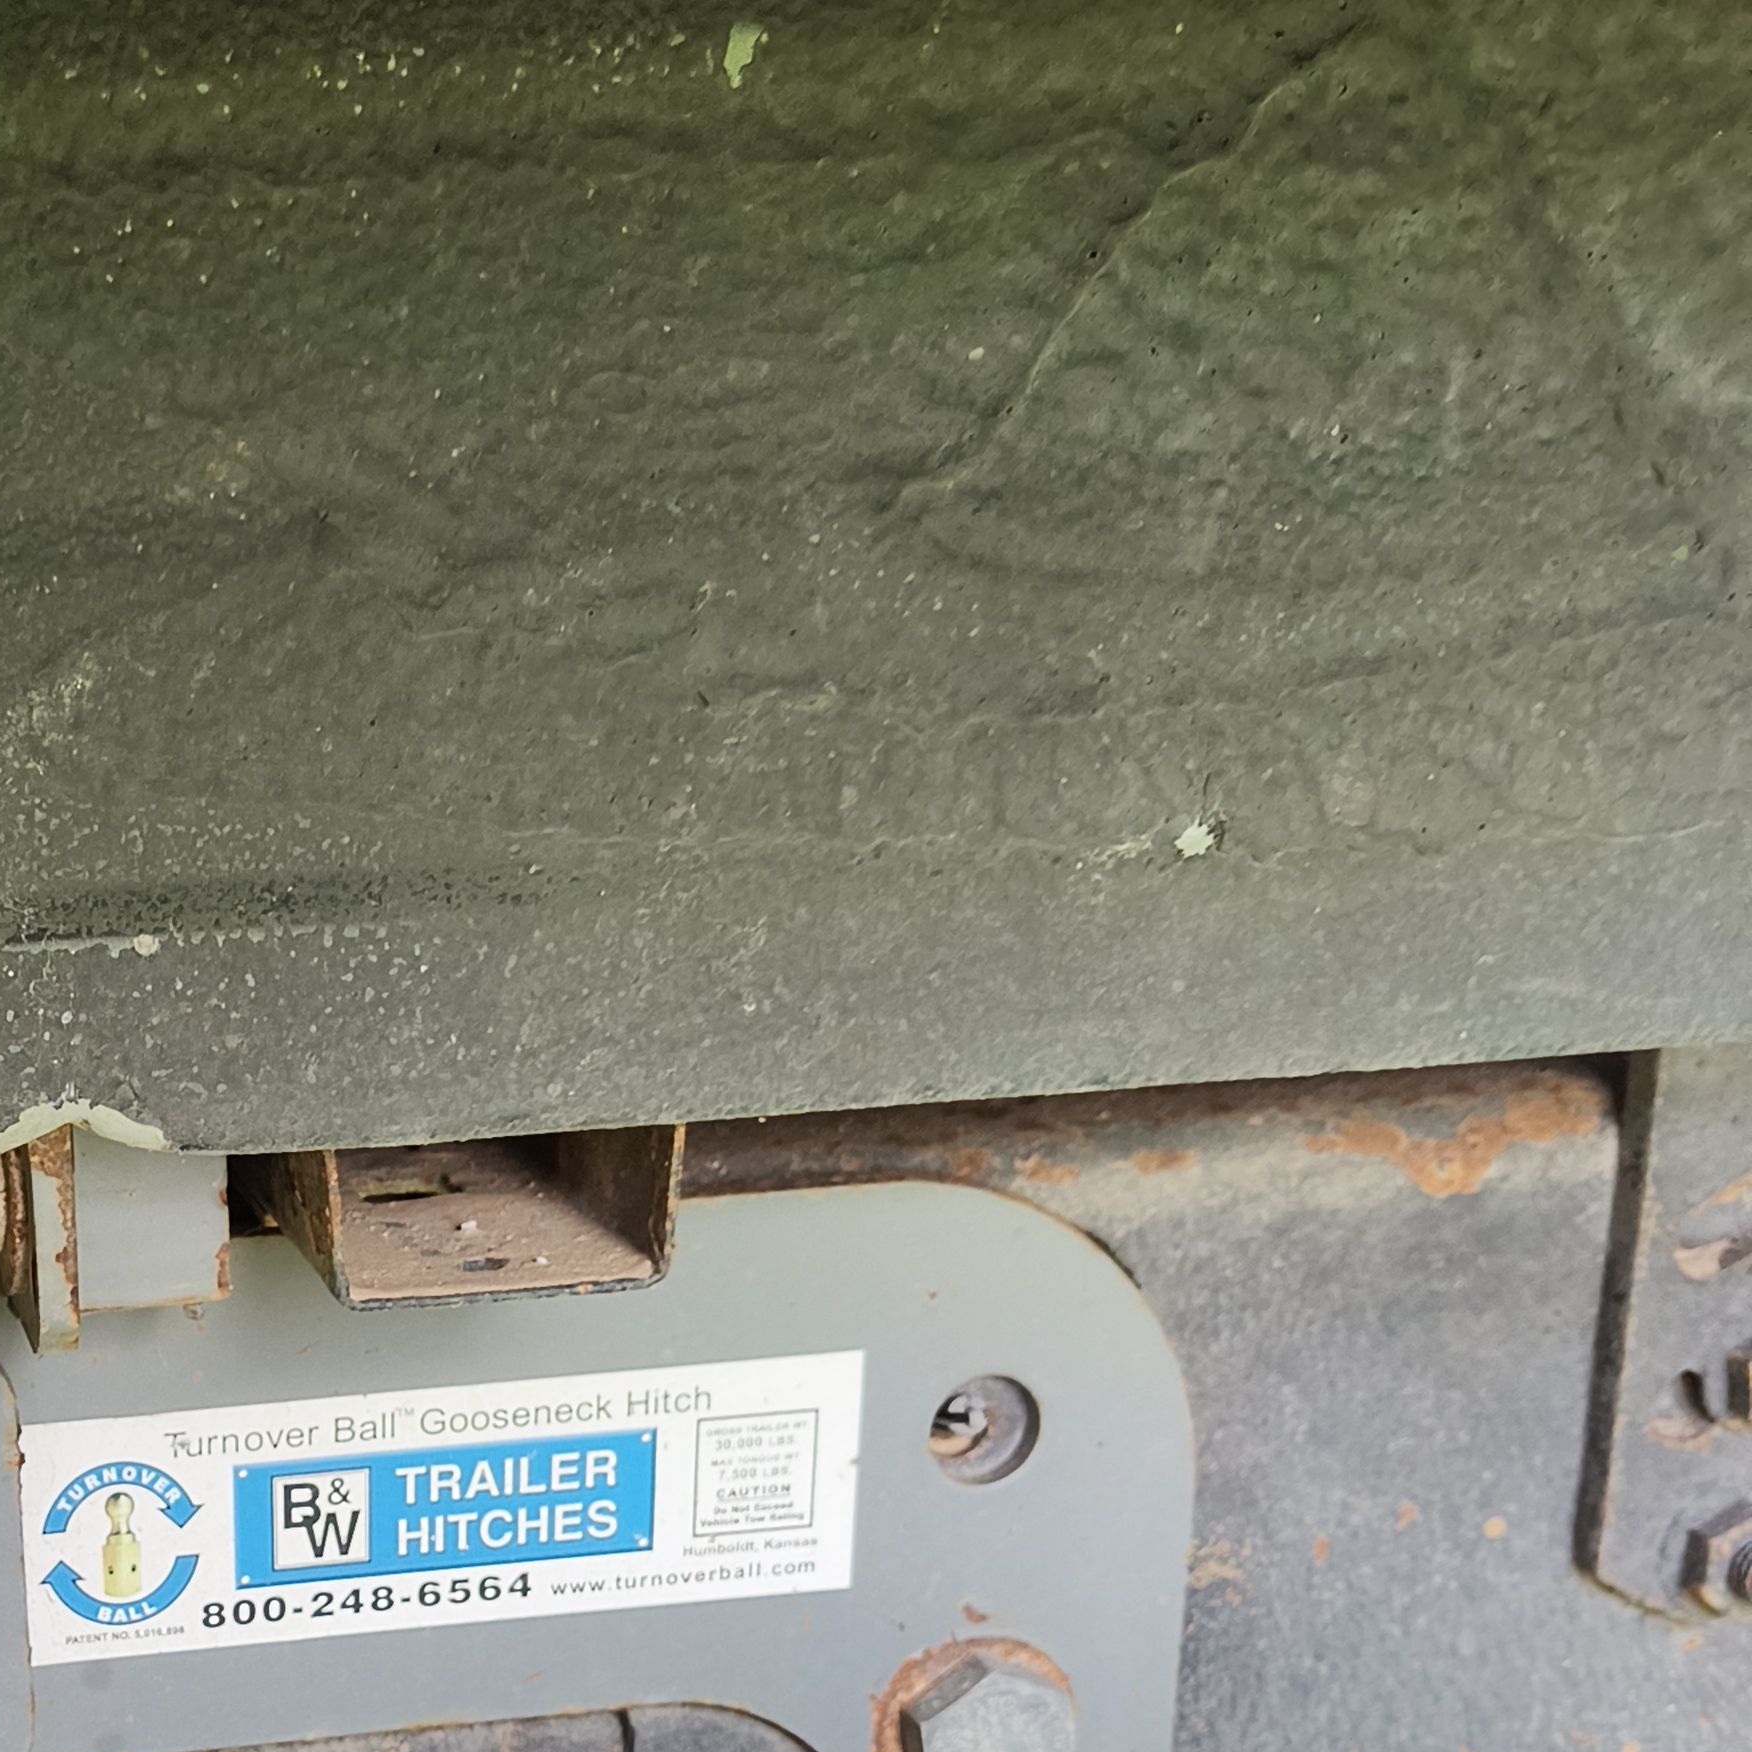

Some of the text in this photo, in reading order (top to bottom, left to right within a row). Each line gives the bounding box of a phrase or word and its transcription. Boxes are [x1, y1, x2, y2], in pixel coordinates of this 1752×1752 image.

[165, 1425, 319, 1458] Turnover
[420, 1395, 613, 1435] Gooseneck
[627, 1386, 712, 1417] Hitch
[55, 1466, 182, 1512] TURNOVER
[396, 1449, 617, 1505] TRAILER
[716, 1484, 791, 1499] CAUTION
[398, 1500, 618, 1556] HITCHES
[700, 1516, 739, 1527] Vehicle
[764, 1537, 818, 1550] Kansas
[550, 1557, 816, 1596] www.turnoverball.com
[97, 1601, 157, 1622] BALL
[202, 1572, 532, 1628] 800-248-6564
[65, 1632, 109, 1645] PATENT
